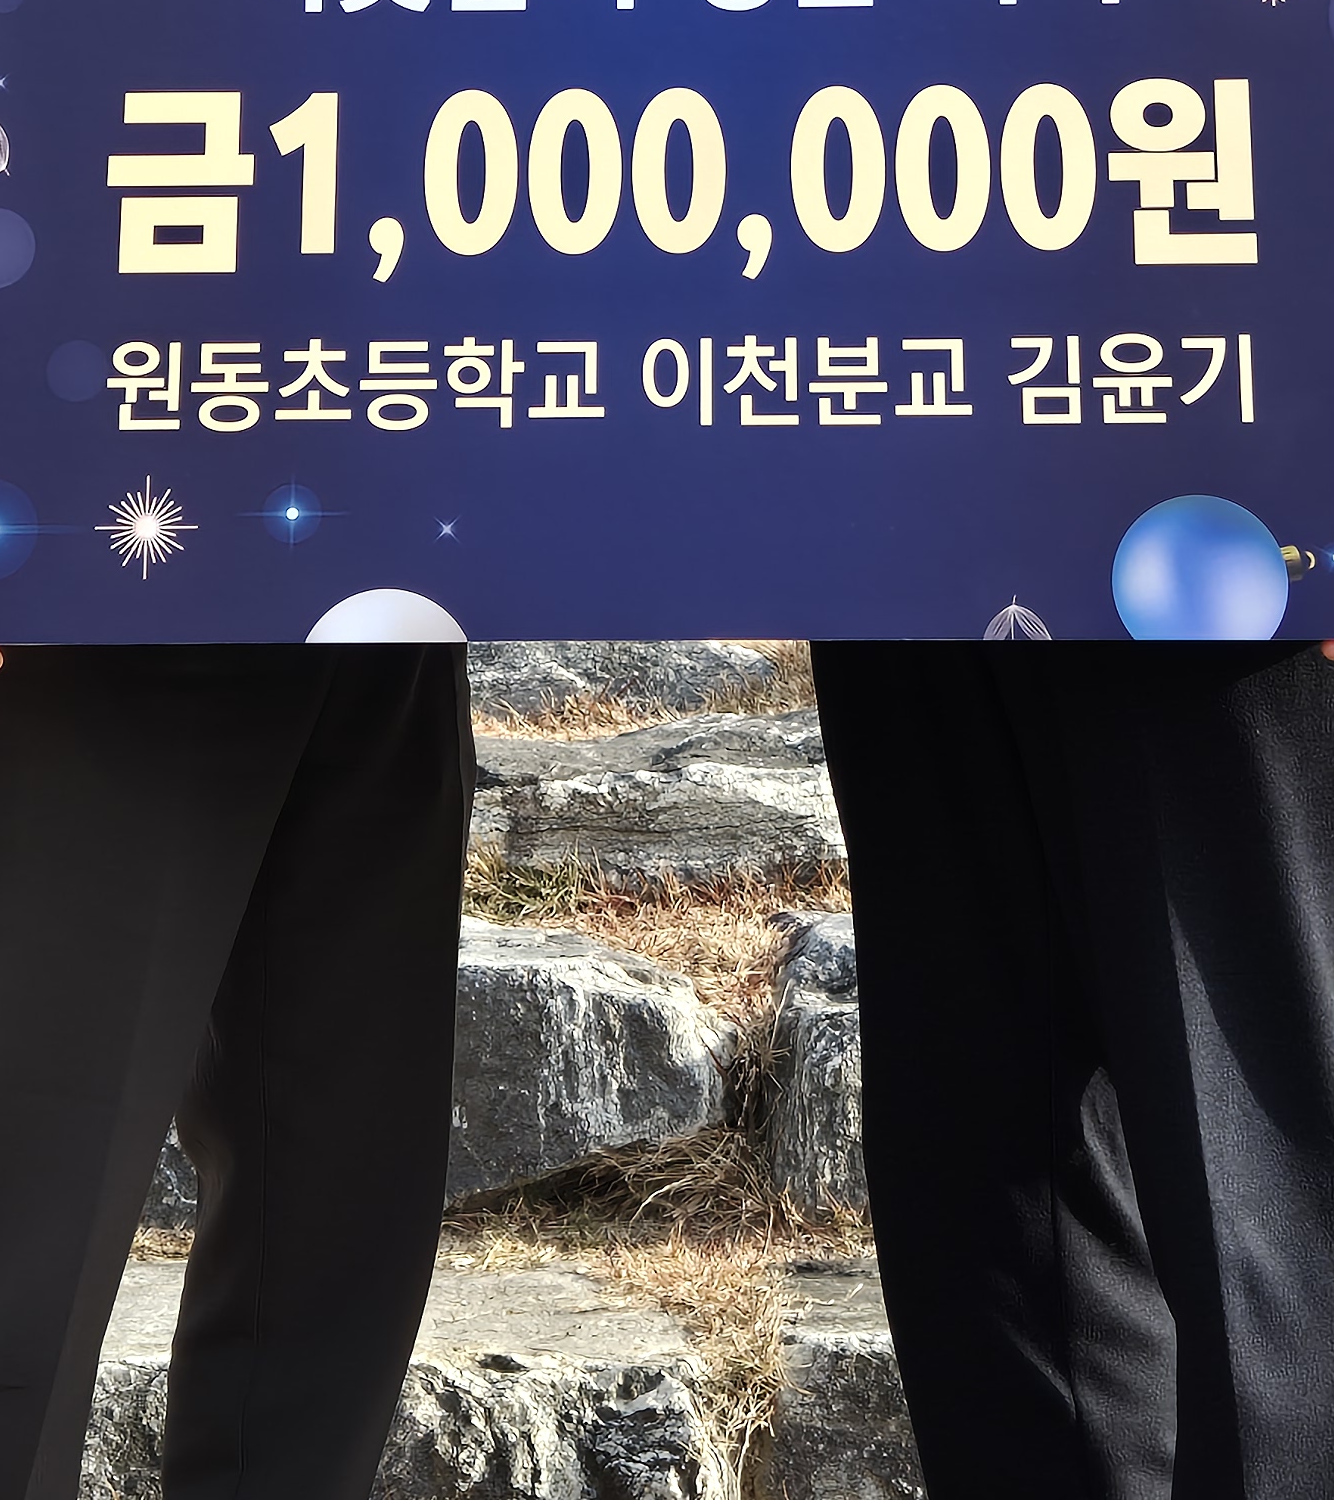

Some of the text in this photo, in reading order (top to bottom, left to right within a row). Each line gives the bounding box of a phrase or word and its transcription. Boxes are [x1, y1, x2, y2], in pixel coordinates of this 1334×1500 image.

[107, 79, 1258, 282] 금1,000,000원
[107, 334, 1254, 431] 원동초등학교 이천분교 김윤기
